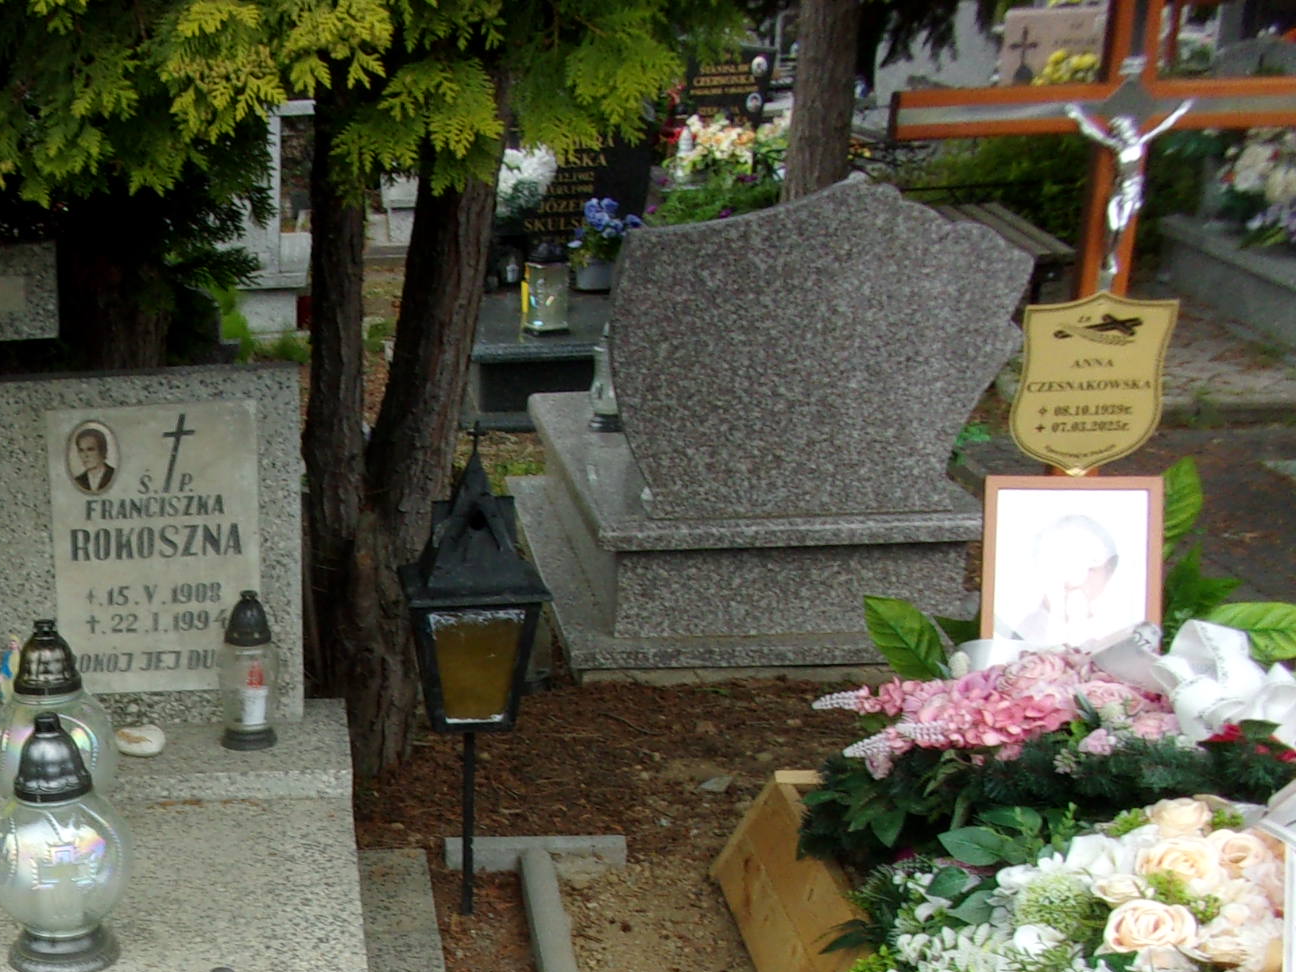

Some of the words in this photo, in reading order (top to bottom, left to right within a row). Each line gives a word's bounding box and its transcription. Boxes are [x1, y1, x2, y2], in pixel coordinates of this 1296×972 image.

[1071, 358, 1114, 368] ANNA
[85, 494, 225, 521] FRANCISZKA
[70, 522, 243, 561] ROKOSZNA
[76, 646, 133, 673] OKÓJ
[139, 650, 182, 671] JEJ
